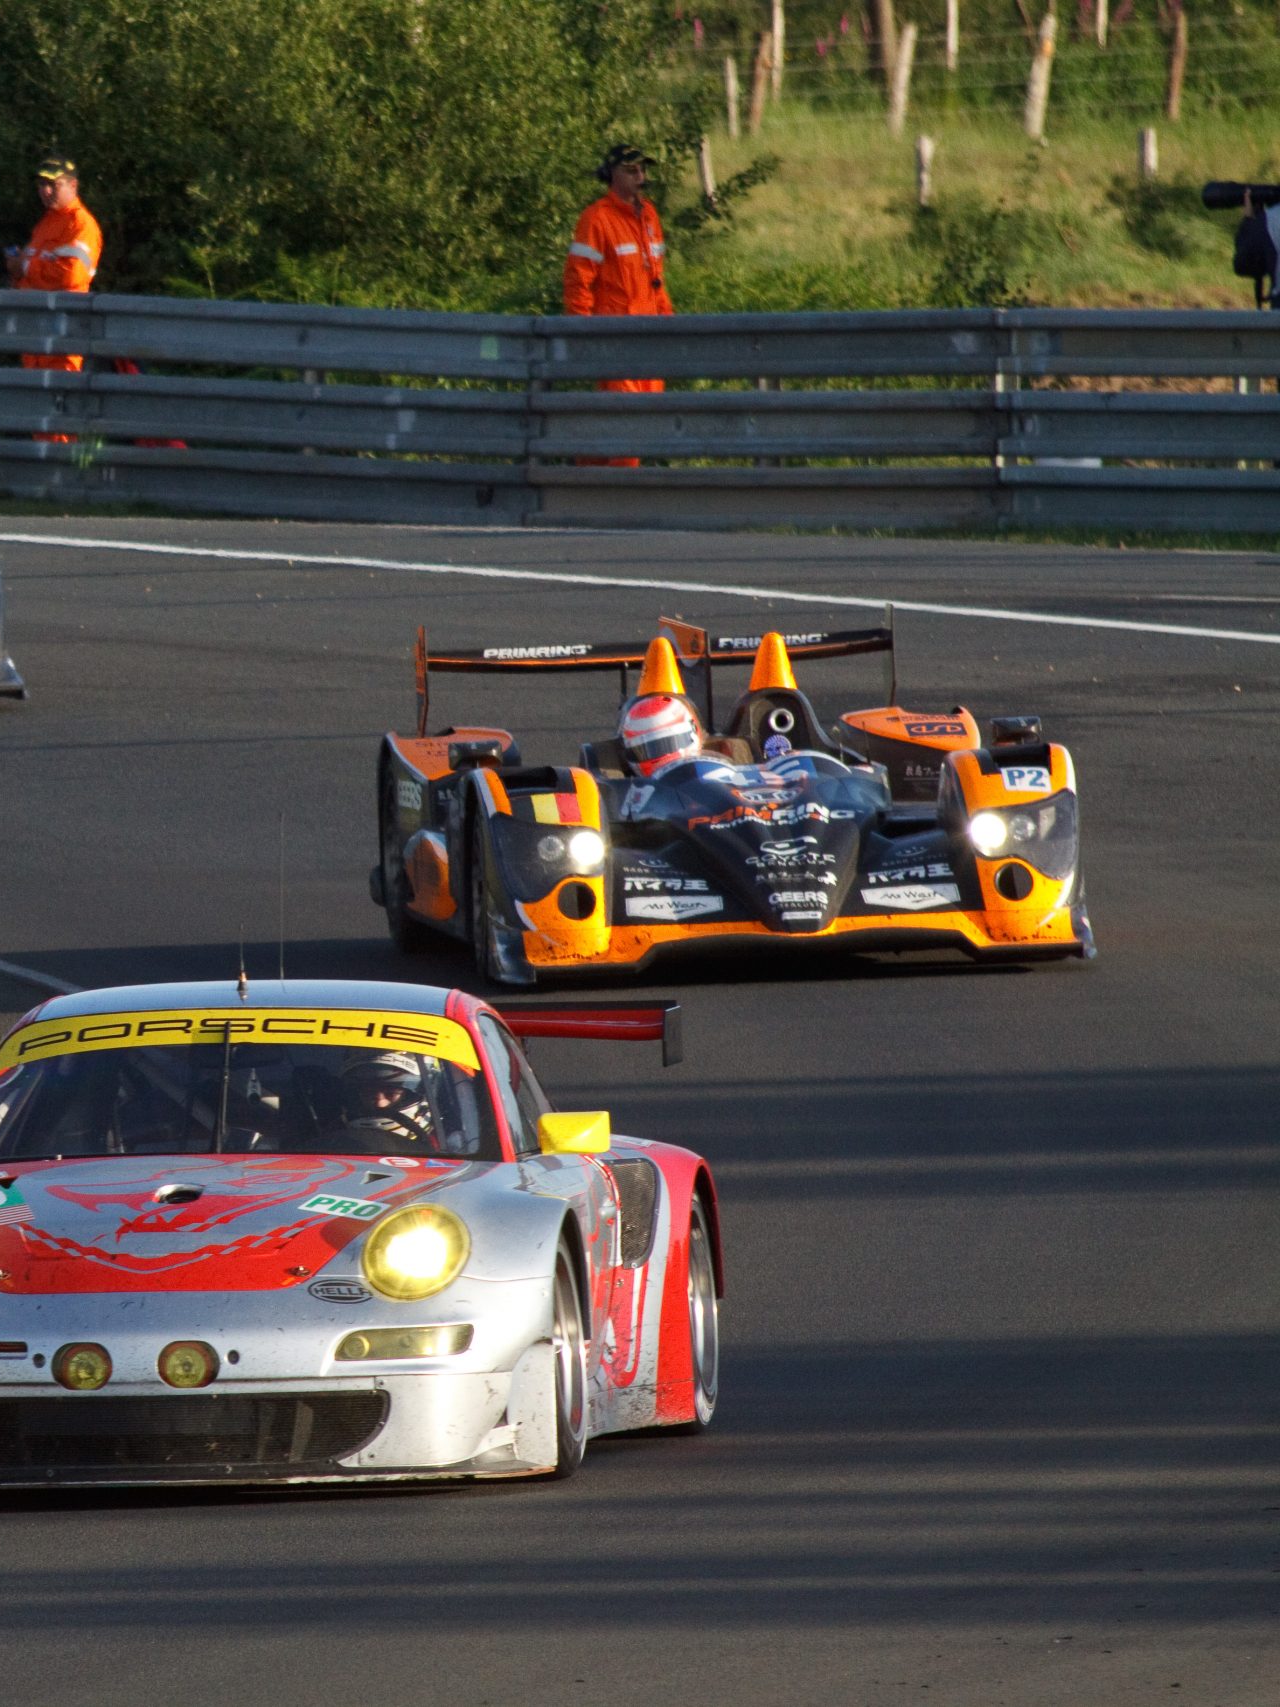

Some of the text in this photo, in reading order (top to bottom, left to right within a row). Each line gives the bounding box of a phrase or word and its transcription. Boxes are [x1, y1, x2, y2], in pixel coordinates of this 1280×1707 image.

[1006, 768, 1046, 788] P2
[745, 852, 836, 866] COYOTE
[768, 891, 829, 906] GEERS
[19, 1018, 438, 1057] PORSCHE
[304, 1196, 383, 1218] PRO
